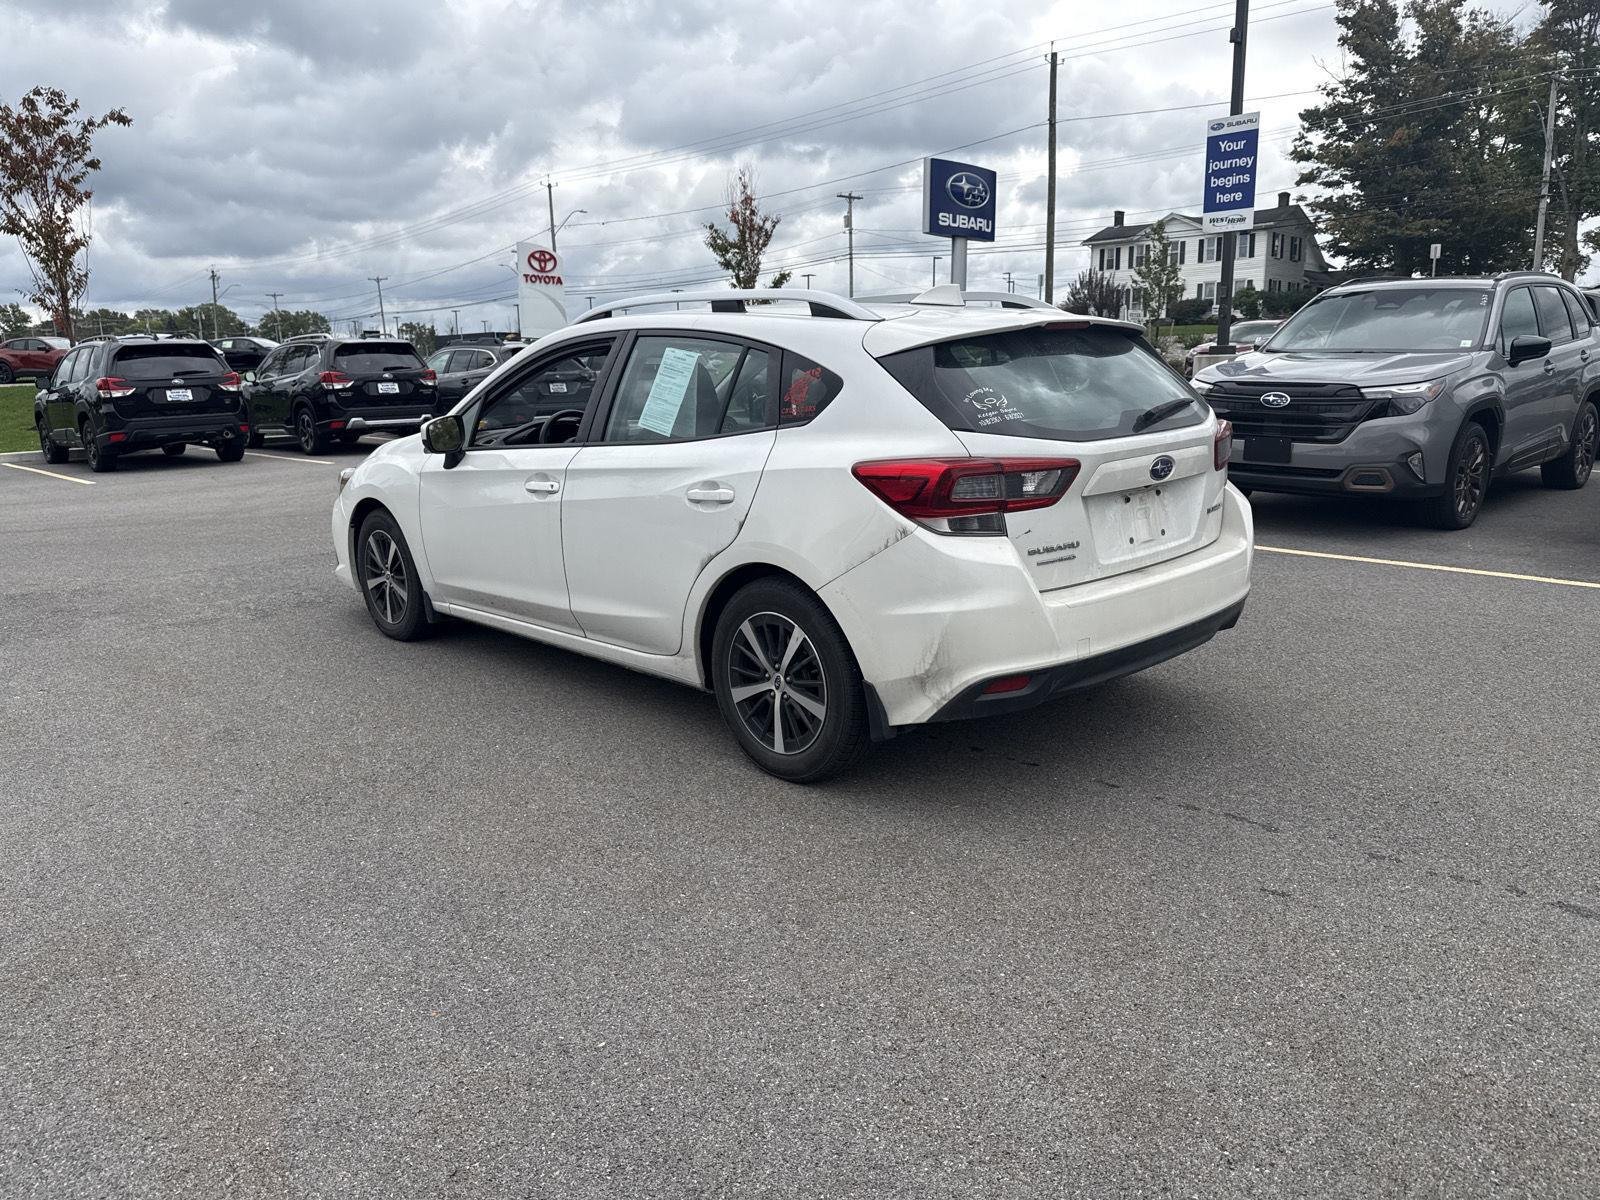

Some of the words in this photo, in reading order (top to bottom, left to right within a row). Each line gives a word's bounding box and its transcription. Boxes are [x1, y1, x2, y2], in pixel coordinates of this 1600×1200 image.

[1226, 118, 1257, 128] SUBARU
[1219, 140, 1246, 152] Your
[1208, 156, 1254, 173] journey
[1210, 173, 1250, 187] begins
[1216, 191, 1242, 203] here
[938, 212, 992, 232] SUBARU
[523, 273, 563, 285] TOYOTA
[1028, 541, 1080, 555] SUBARU
